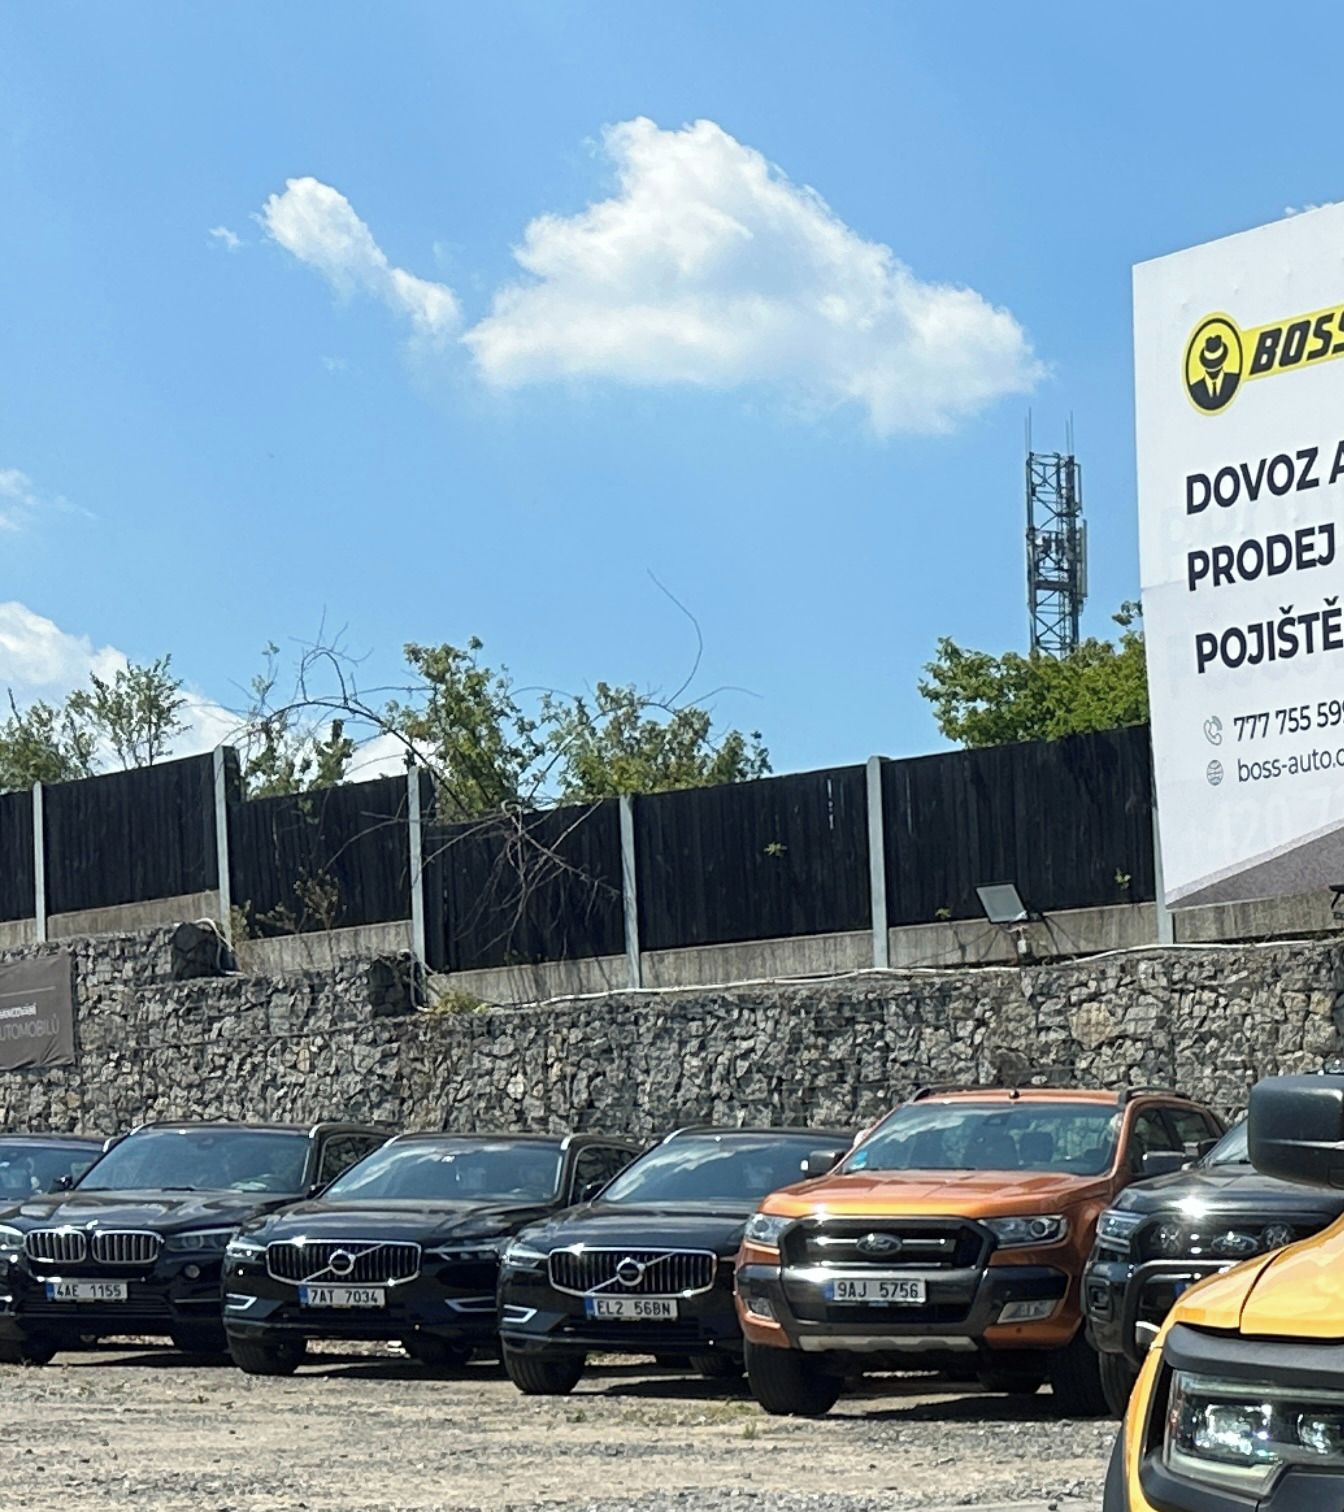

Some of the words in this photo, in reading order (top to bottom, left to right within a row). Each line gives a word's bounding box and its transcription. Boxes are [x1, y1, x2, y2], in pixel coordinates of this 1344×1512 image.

[1186, 446, 1320, 515] DOVOZ
[1187, 522, 1335, 592] PRODEJ
[1233, 712, 1270, 742] 777
[1275, 705, 1312, 735] 755
[90, 1284, 121, 1297] 1155
[345, 1290, 378, 1303] 7034
[837, 1281, 867, 1298] 9AJ
[879, 1282, 919, 1299] 5756
